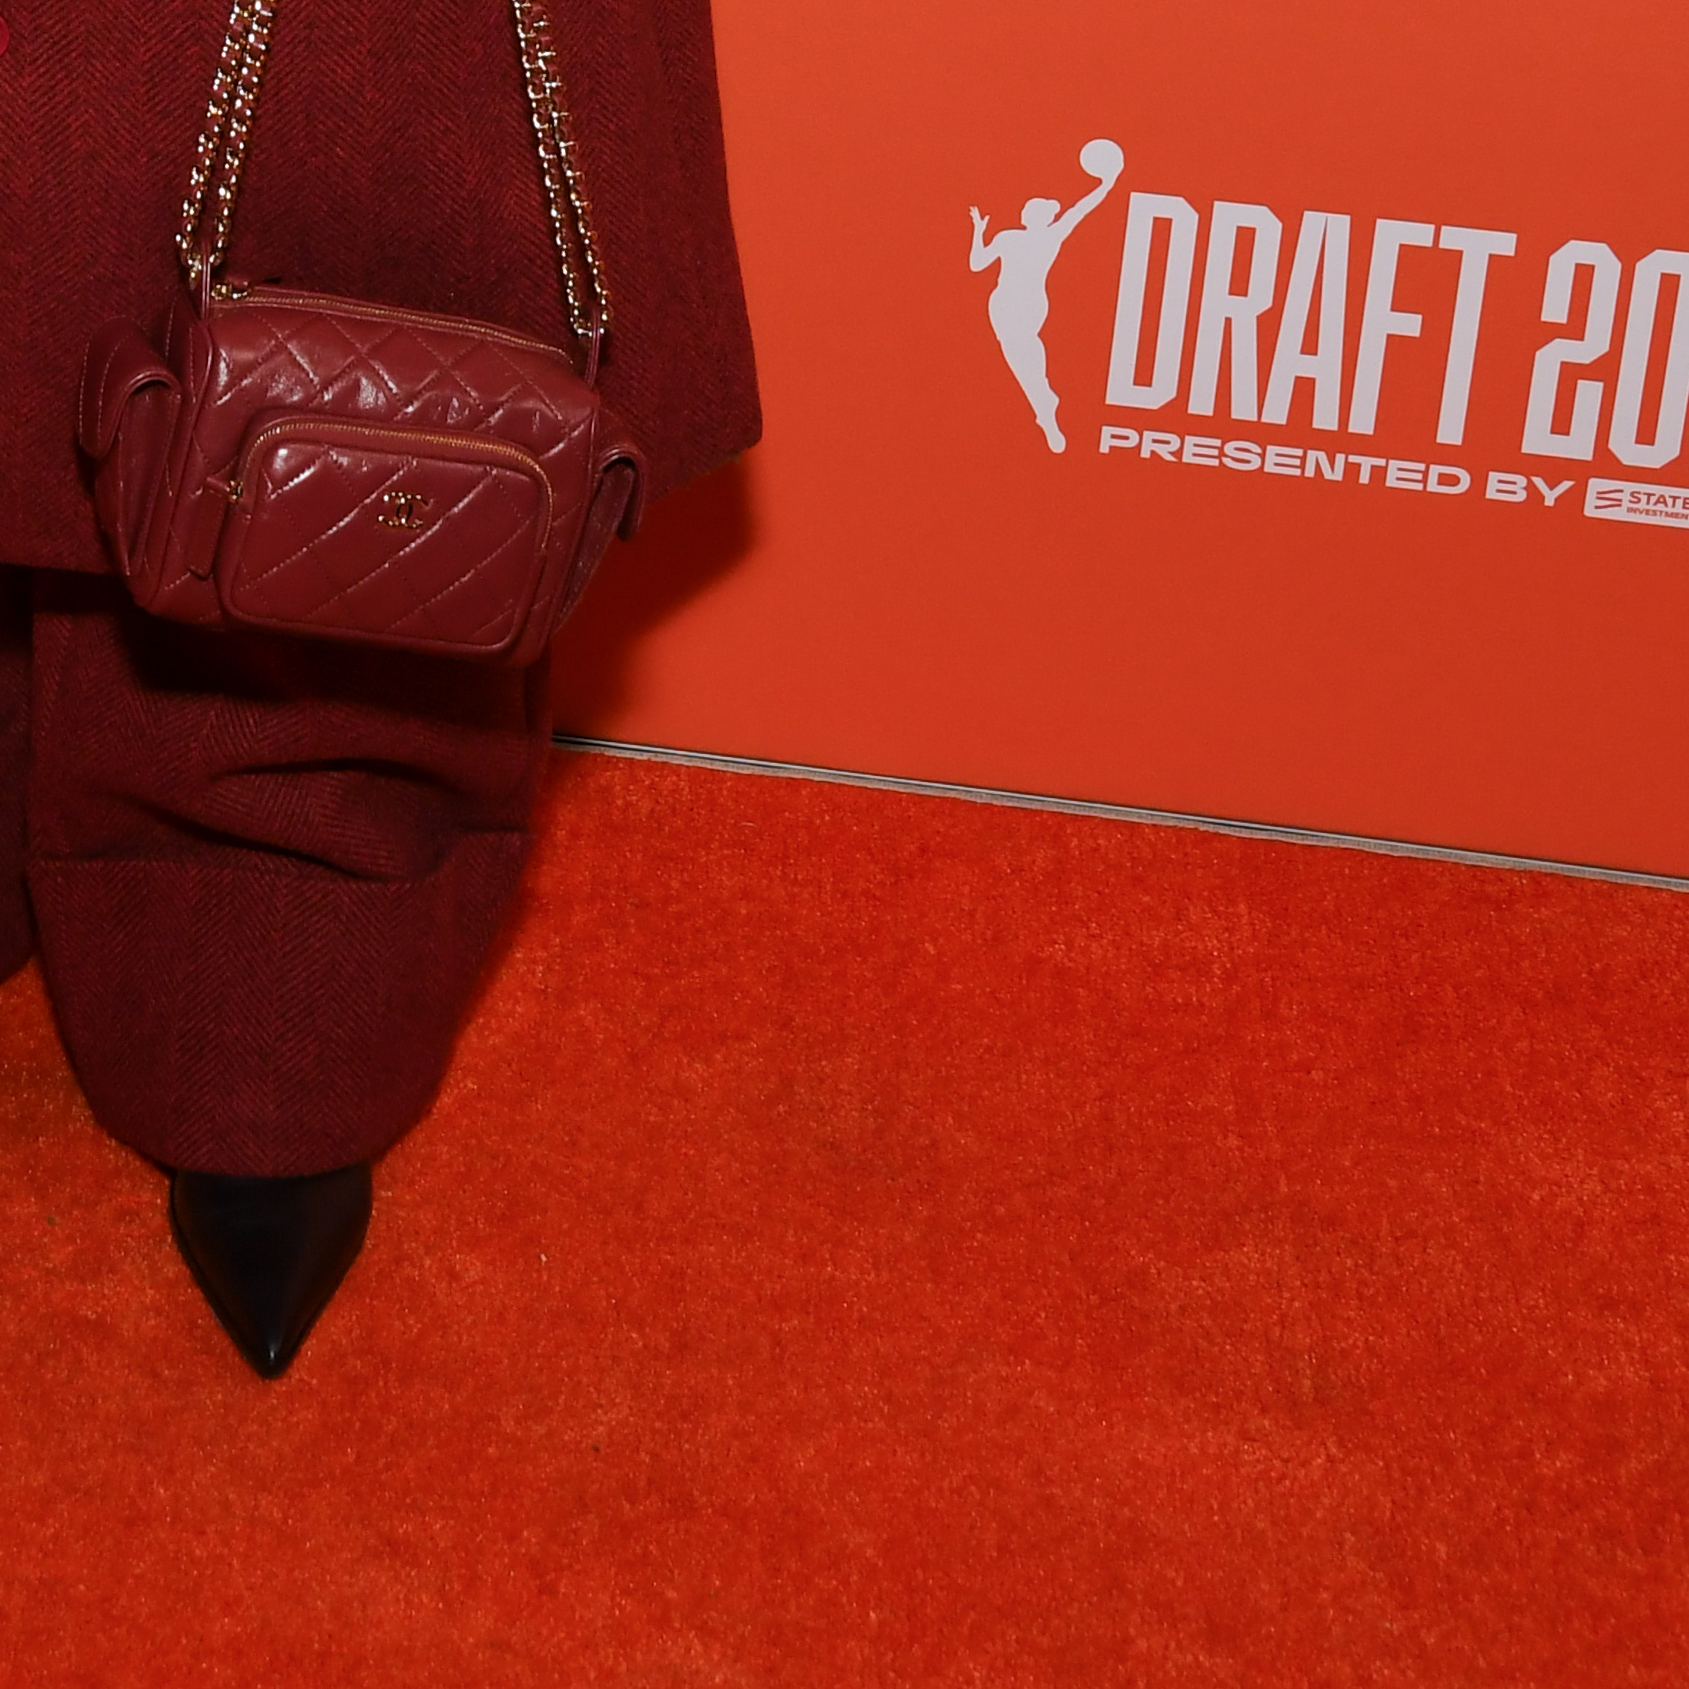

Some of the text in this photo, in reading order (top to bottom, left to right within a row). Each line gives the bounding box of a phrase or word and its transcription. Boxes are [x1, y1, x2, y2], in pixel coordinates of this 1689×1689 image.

[1105, 191, 1689, 470] DRAFT 20
[1099, 425, 1575, 507] PRESENTED BY
